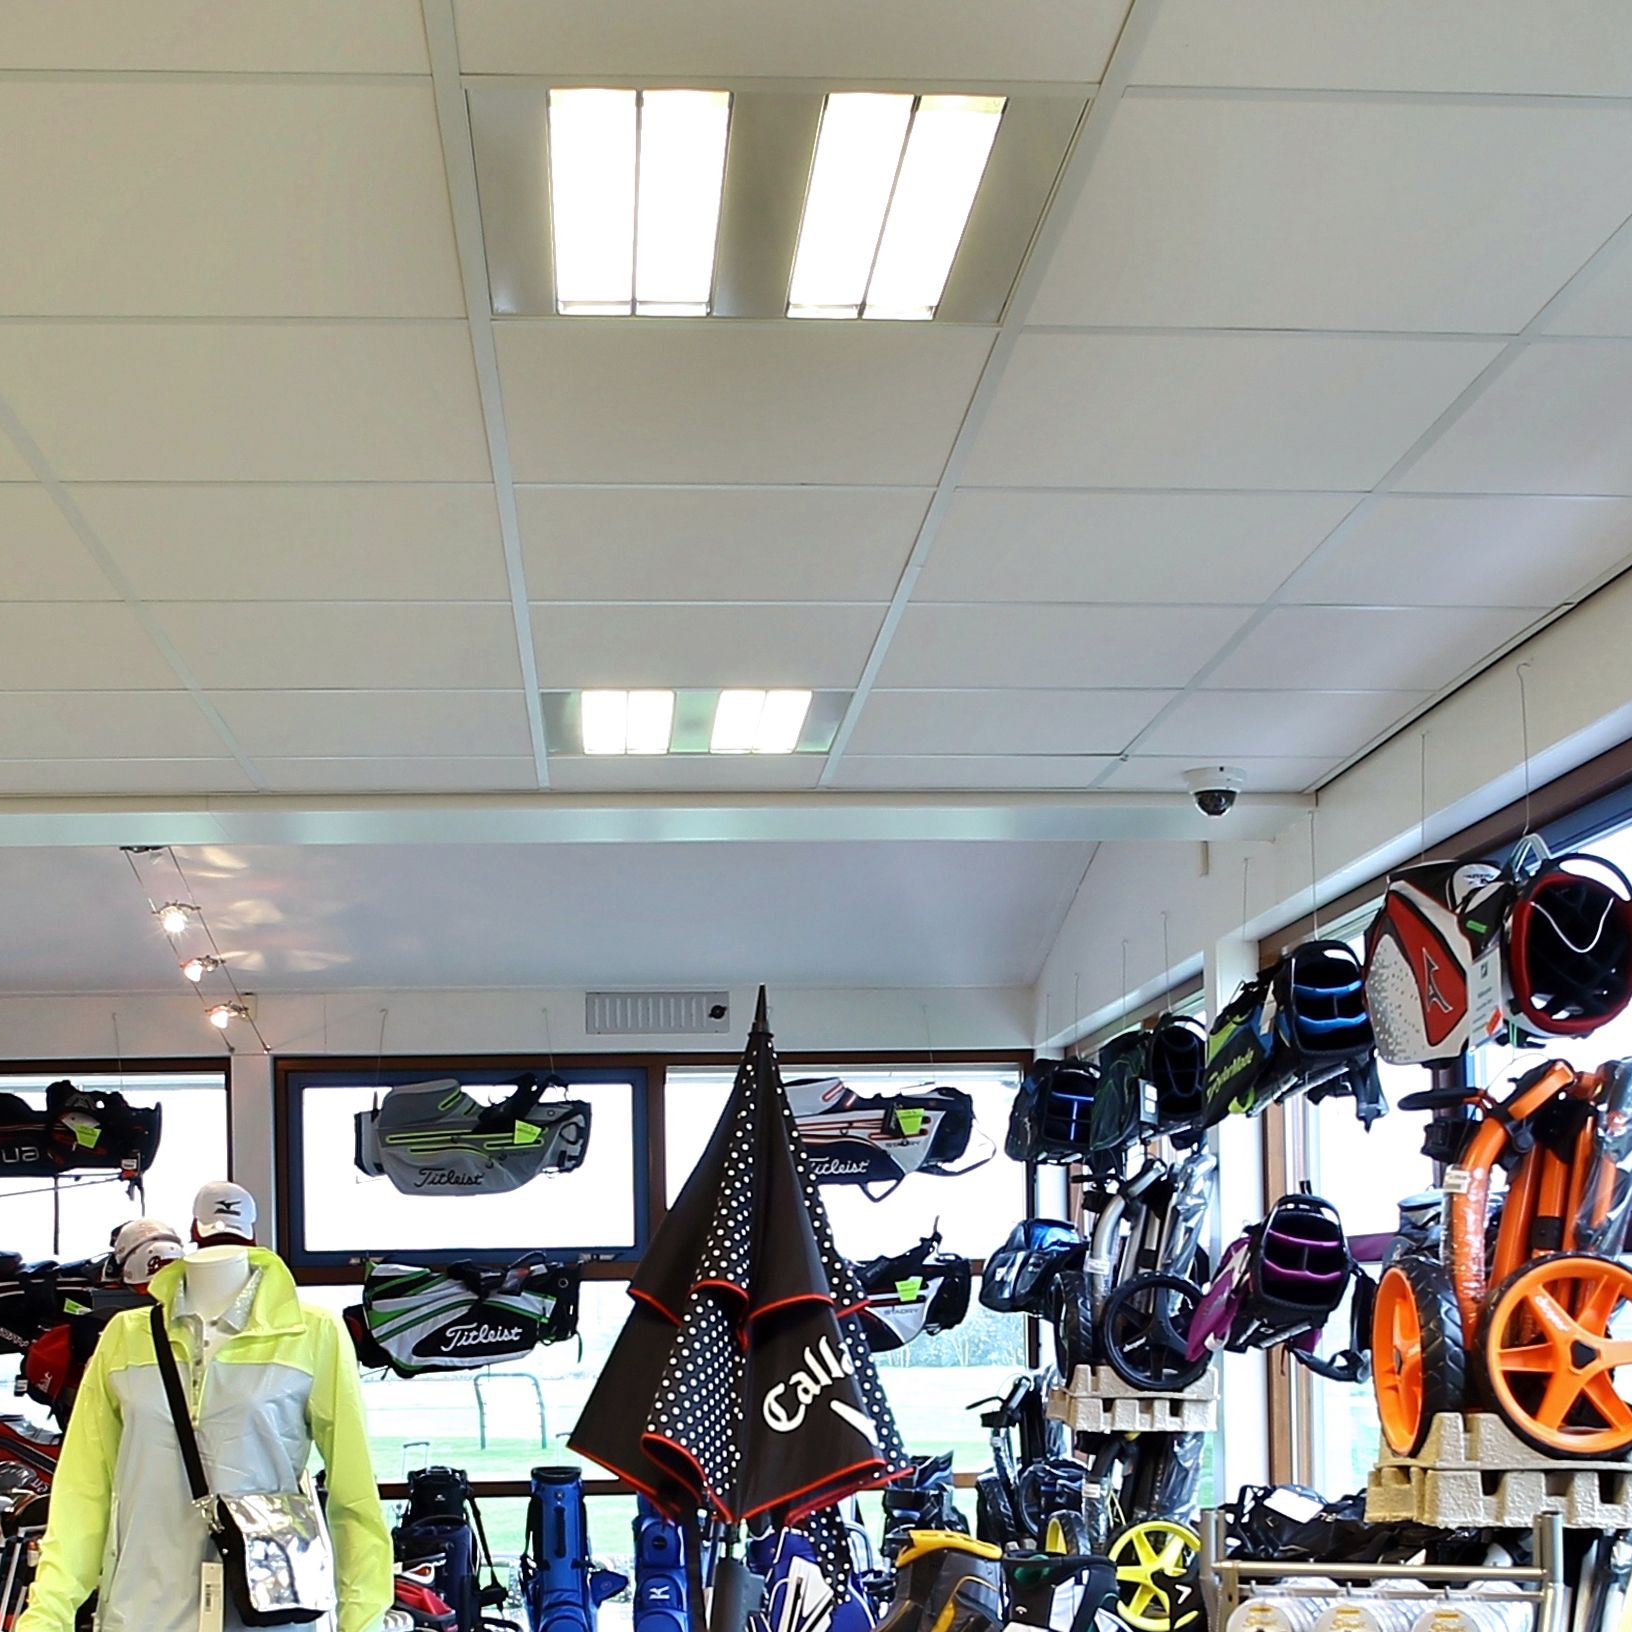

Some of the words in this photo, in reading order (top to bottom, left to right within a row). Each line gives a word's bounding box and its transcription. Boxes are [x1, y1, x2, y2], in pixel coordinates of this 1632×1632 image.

[414, 1167, 485, 1189] Titleist
[807, 1156, 869, 1176] itleist
[441, 1322, 523, 1352] Titleist
[763, 1335, 856, 1432] Calla
